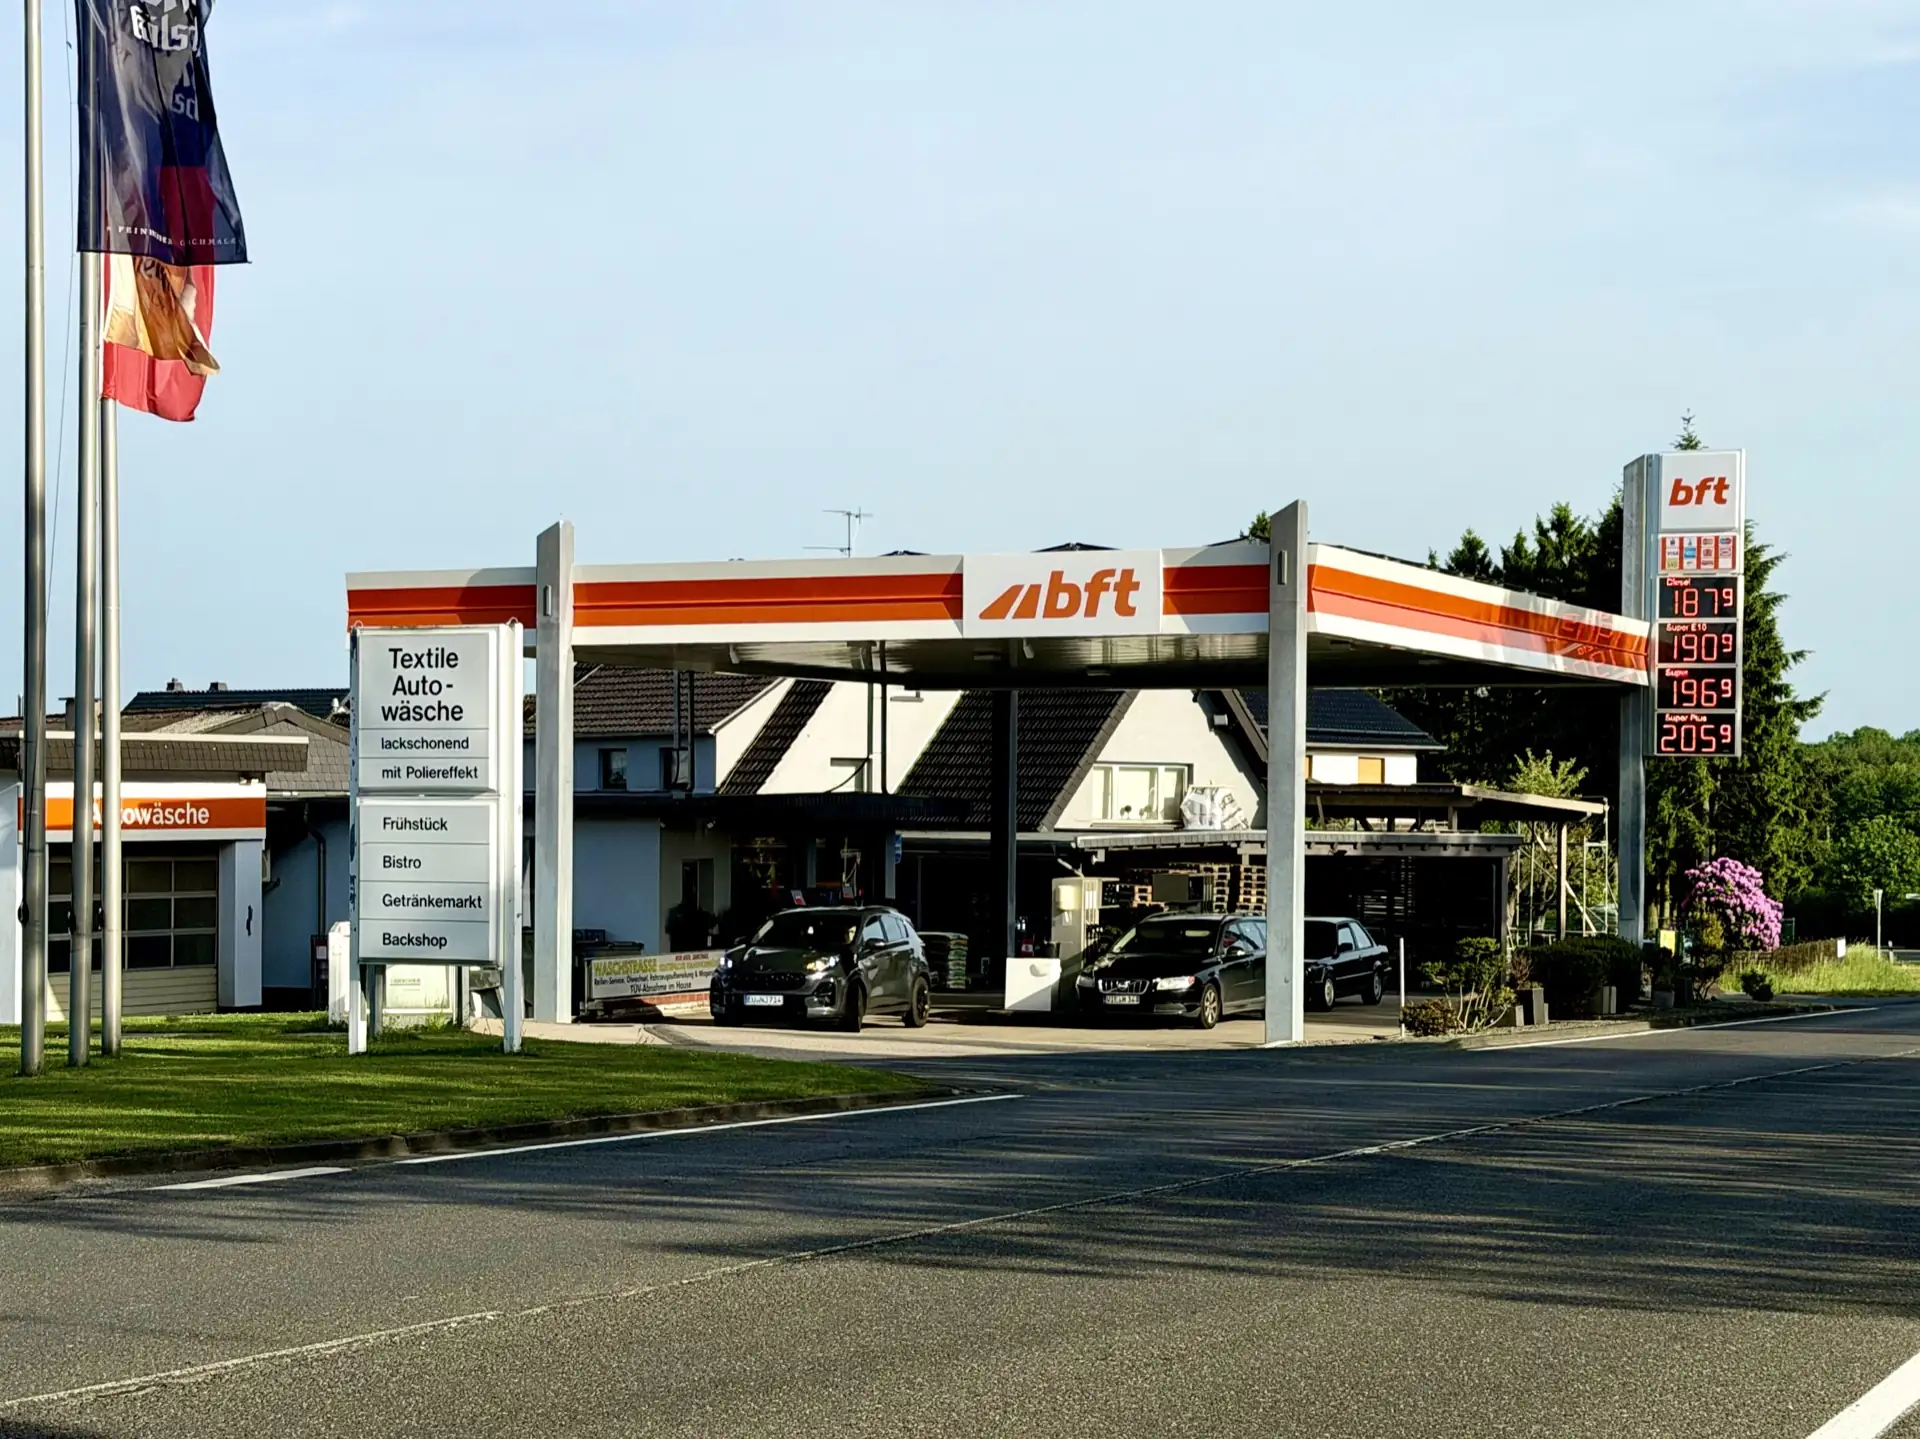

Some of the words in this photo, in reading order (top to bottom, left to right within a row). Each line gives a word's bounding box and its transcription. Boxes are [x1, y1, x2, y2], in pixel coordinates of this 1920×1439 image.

[1669, 477, 1730, 506] bft
[1666, 577, 1691, 587] Diesel
[1042, 568, 1141, 619] bft
[1666, 623, 1689, 632] Super
[388, 648, 459, 669] Textile
[1665, 668, 1689, 677] Super
[381, 700, 464, 722] wäsche
[1665, 713, 1689, 722] Super
[1690, 713, 1707, 722] Plus
[381, 736, 469, 750] lackschonend
[382, 766, 402, 779] mit
[406, 765, 479, 780] Poliereffekt
[382, 816, 448, 831] Frühstück
[382, 855, 422, 869] Bistro
[382, 893, 483, 909] Getränkemarkt
[382, 932, 448, 950] Backshop
